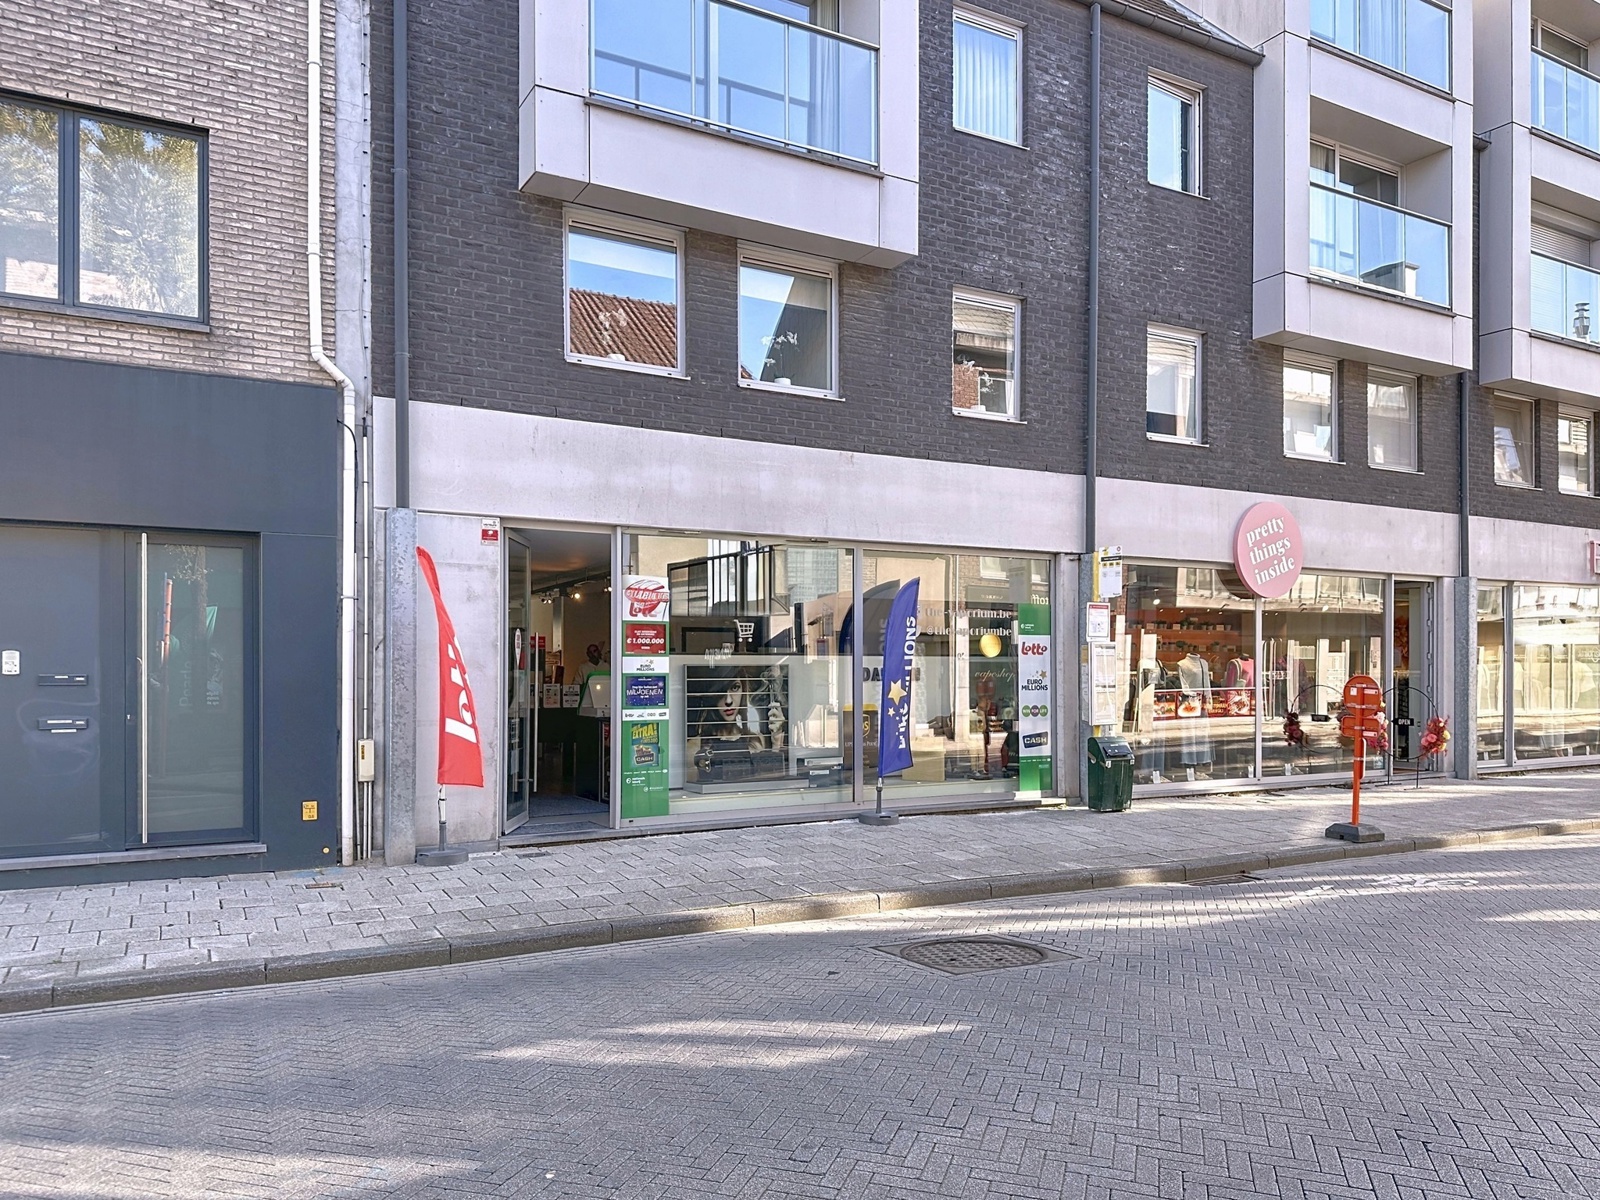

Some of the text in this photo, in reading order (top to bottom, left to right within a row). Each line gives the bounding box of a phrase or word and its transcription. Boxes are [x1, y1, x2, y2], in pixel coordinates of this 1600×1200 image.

[1246, 517, 1284, 547] pretty
[1249, 537, 1291, 565] things
[1254, 557, 1295, 585] inside
[1021, 642, 1048, 655] Lotto
[626, 688, 664, 696] MILJOENEN
[632, 723, 658, 739] EXTRA!
